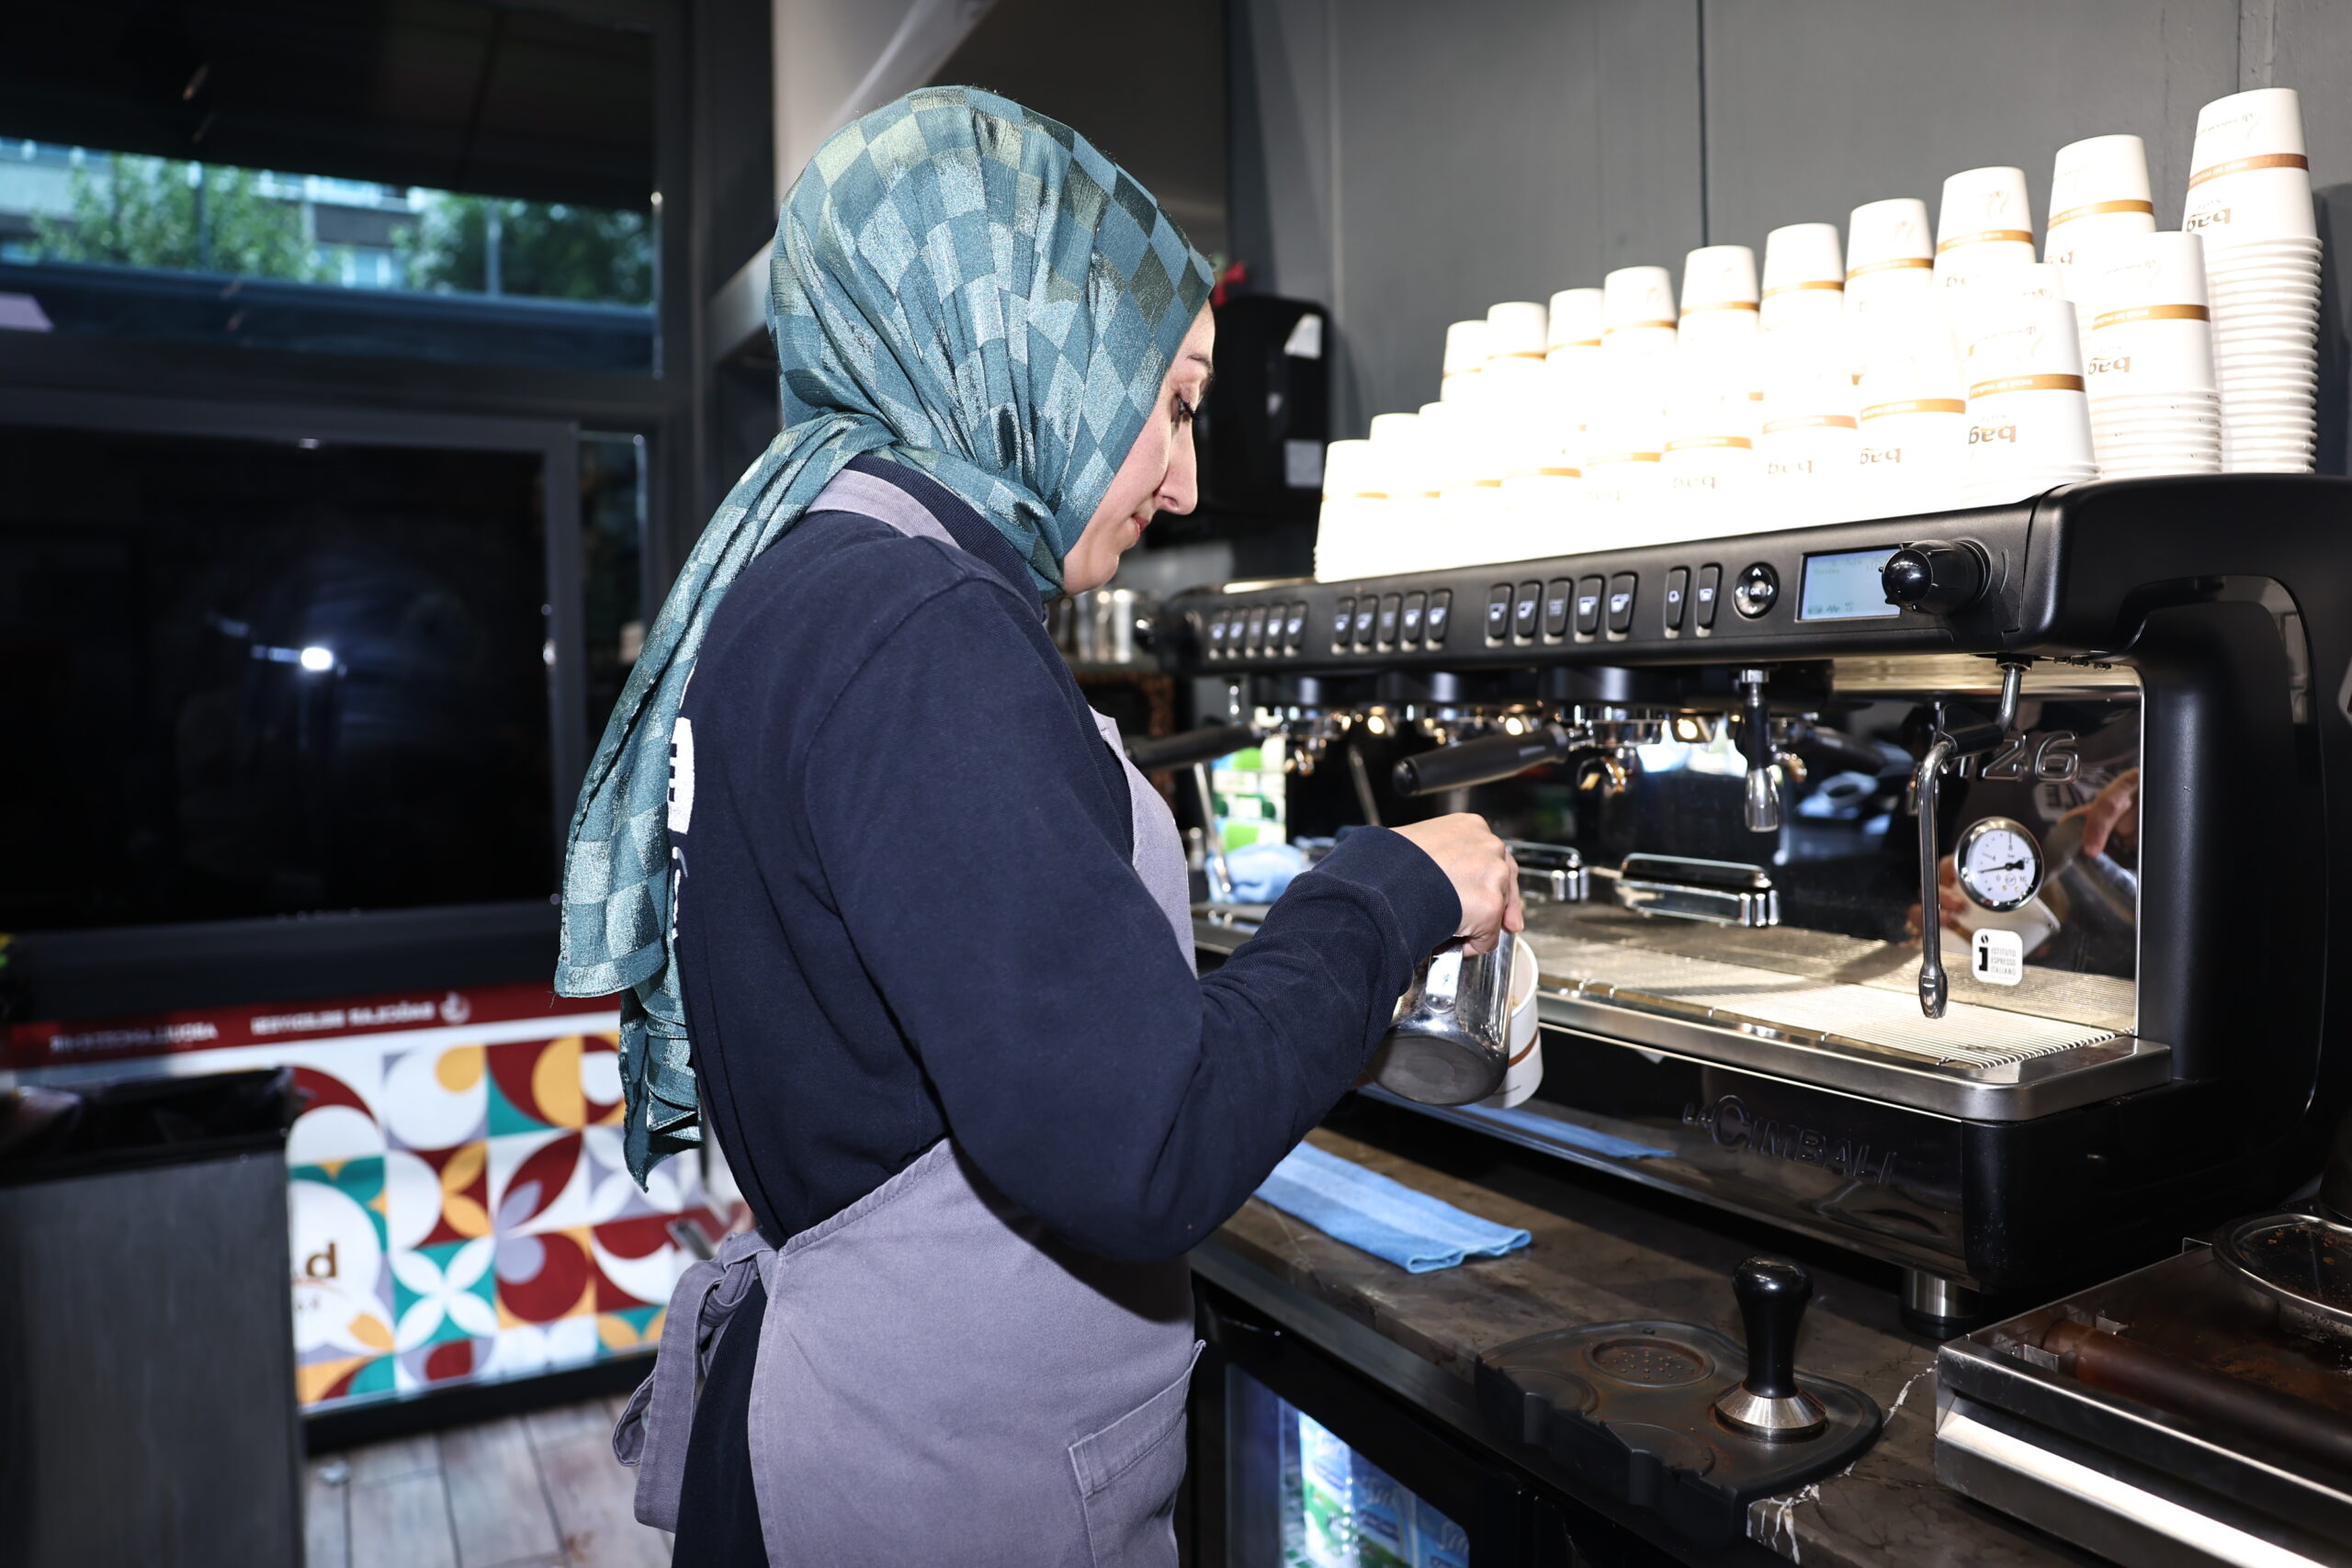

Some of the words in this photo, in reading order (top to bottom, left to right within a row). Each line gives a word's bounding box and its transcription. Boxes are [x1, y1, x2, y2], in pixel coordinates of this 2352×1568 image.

[1749, 587, 1761, 596] OK
[1991, 947, 2017, 957] ISTITUTO
[1991, 957, 2017, 966] ESPRESSO
[1990, 965, 2017, 976] ITALIANO
